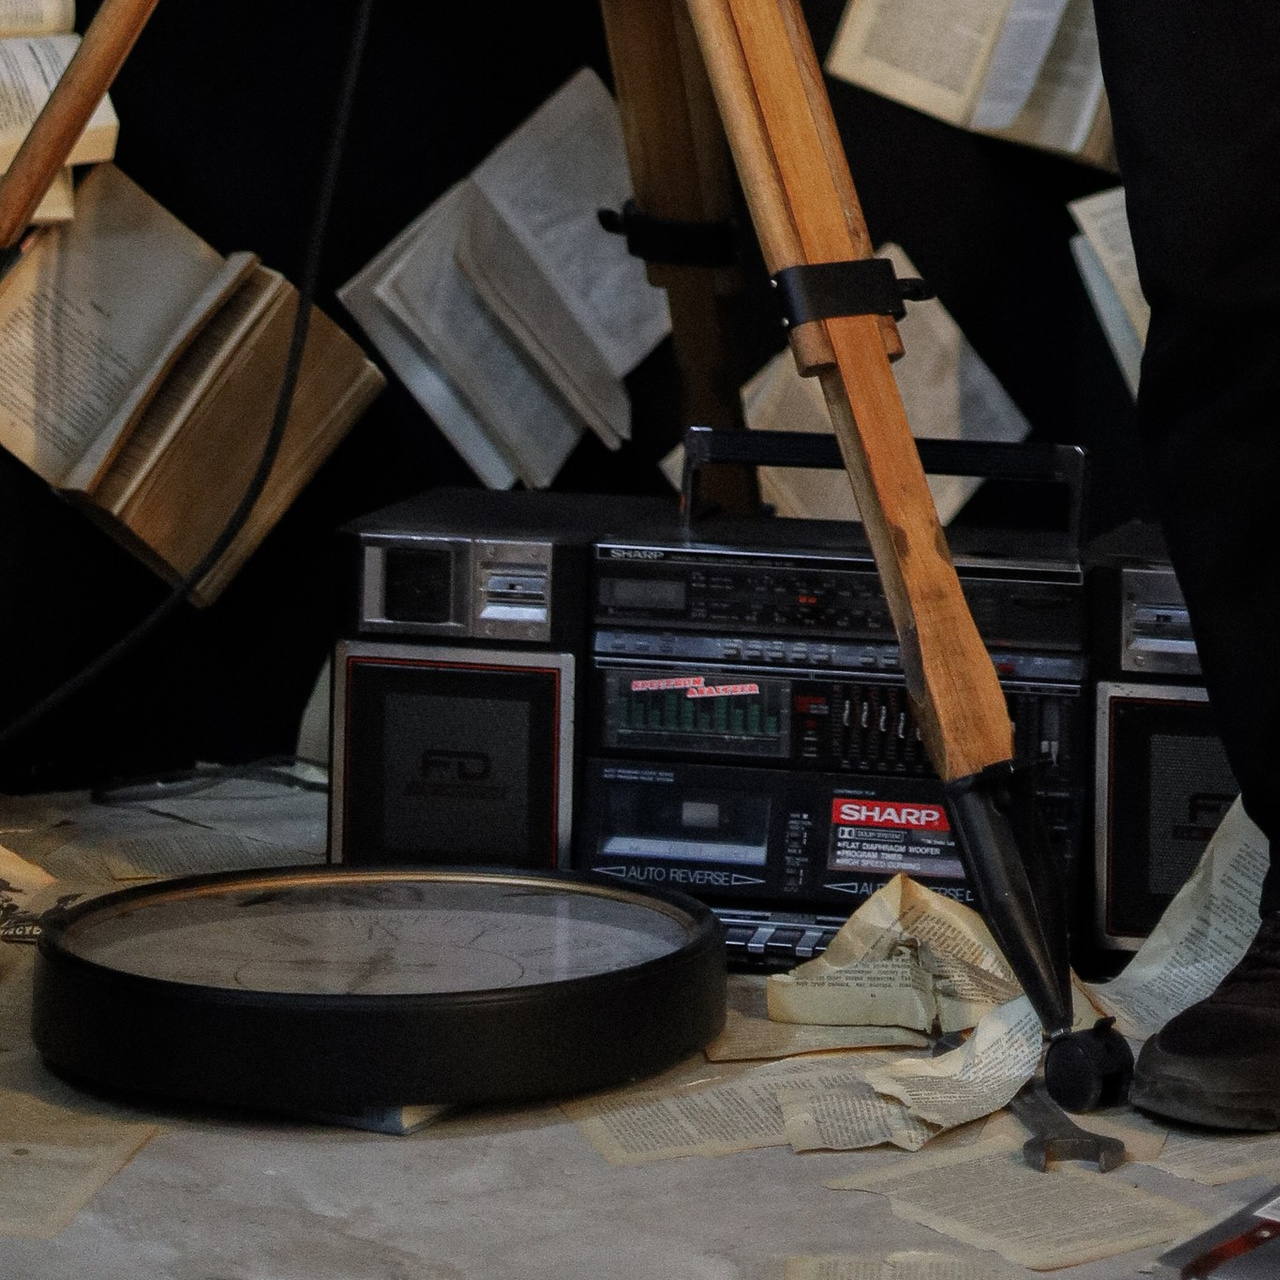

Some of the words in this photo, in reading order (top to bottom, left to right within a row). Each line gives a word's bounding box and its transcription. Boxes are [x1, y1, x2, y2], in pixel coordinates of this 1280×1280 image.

[610, 549, 664, 559] SHARP
[840, 803, 940, 826] SHARP
[908, 846, 941, 855] WOOFER
[627, 866, 666, 881] AUTO
[669, 868, 730, 886] REVERSE
